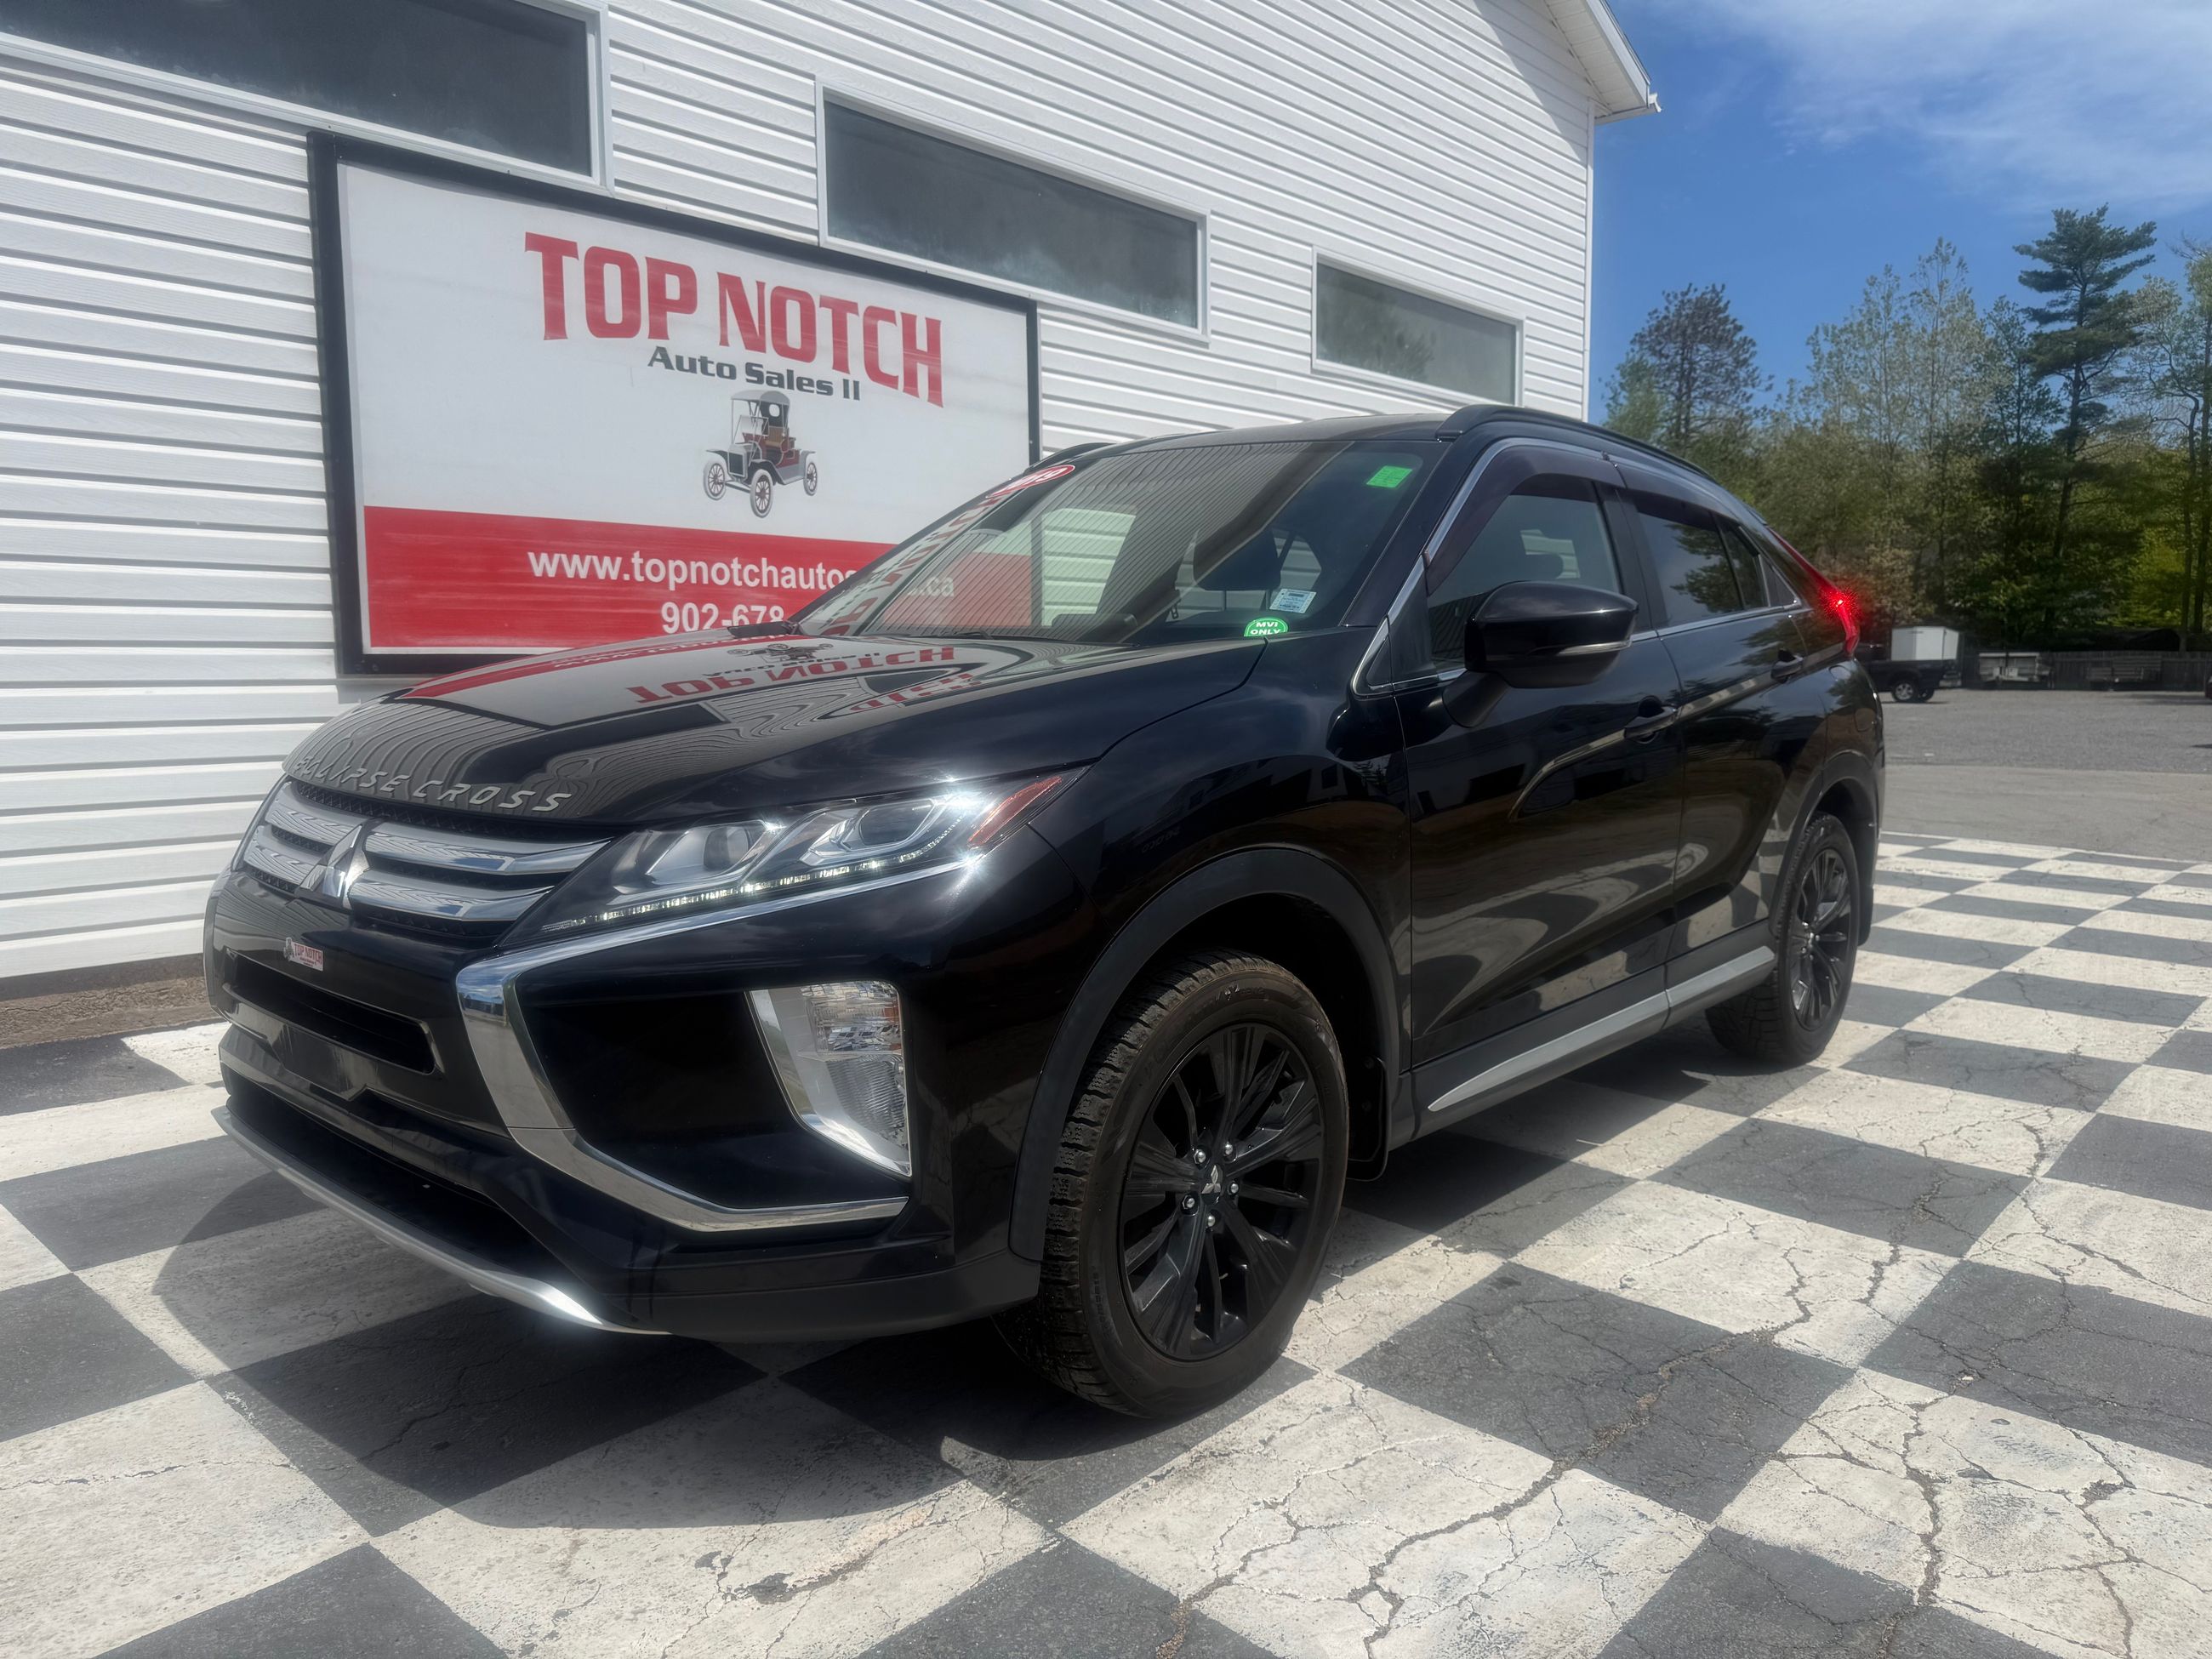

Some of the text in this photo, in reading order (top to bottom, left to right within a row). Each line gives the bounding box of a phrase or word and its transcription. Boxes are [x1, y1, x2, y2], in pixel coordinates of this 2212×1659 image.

[525, 232, 944, 408] TOP NOTCH
[647, 346, 860, 401] Auto Sales II
[294, 755, 573, 812] ECLIPSE CROSS
